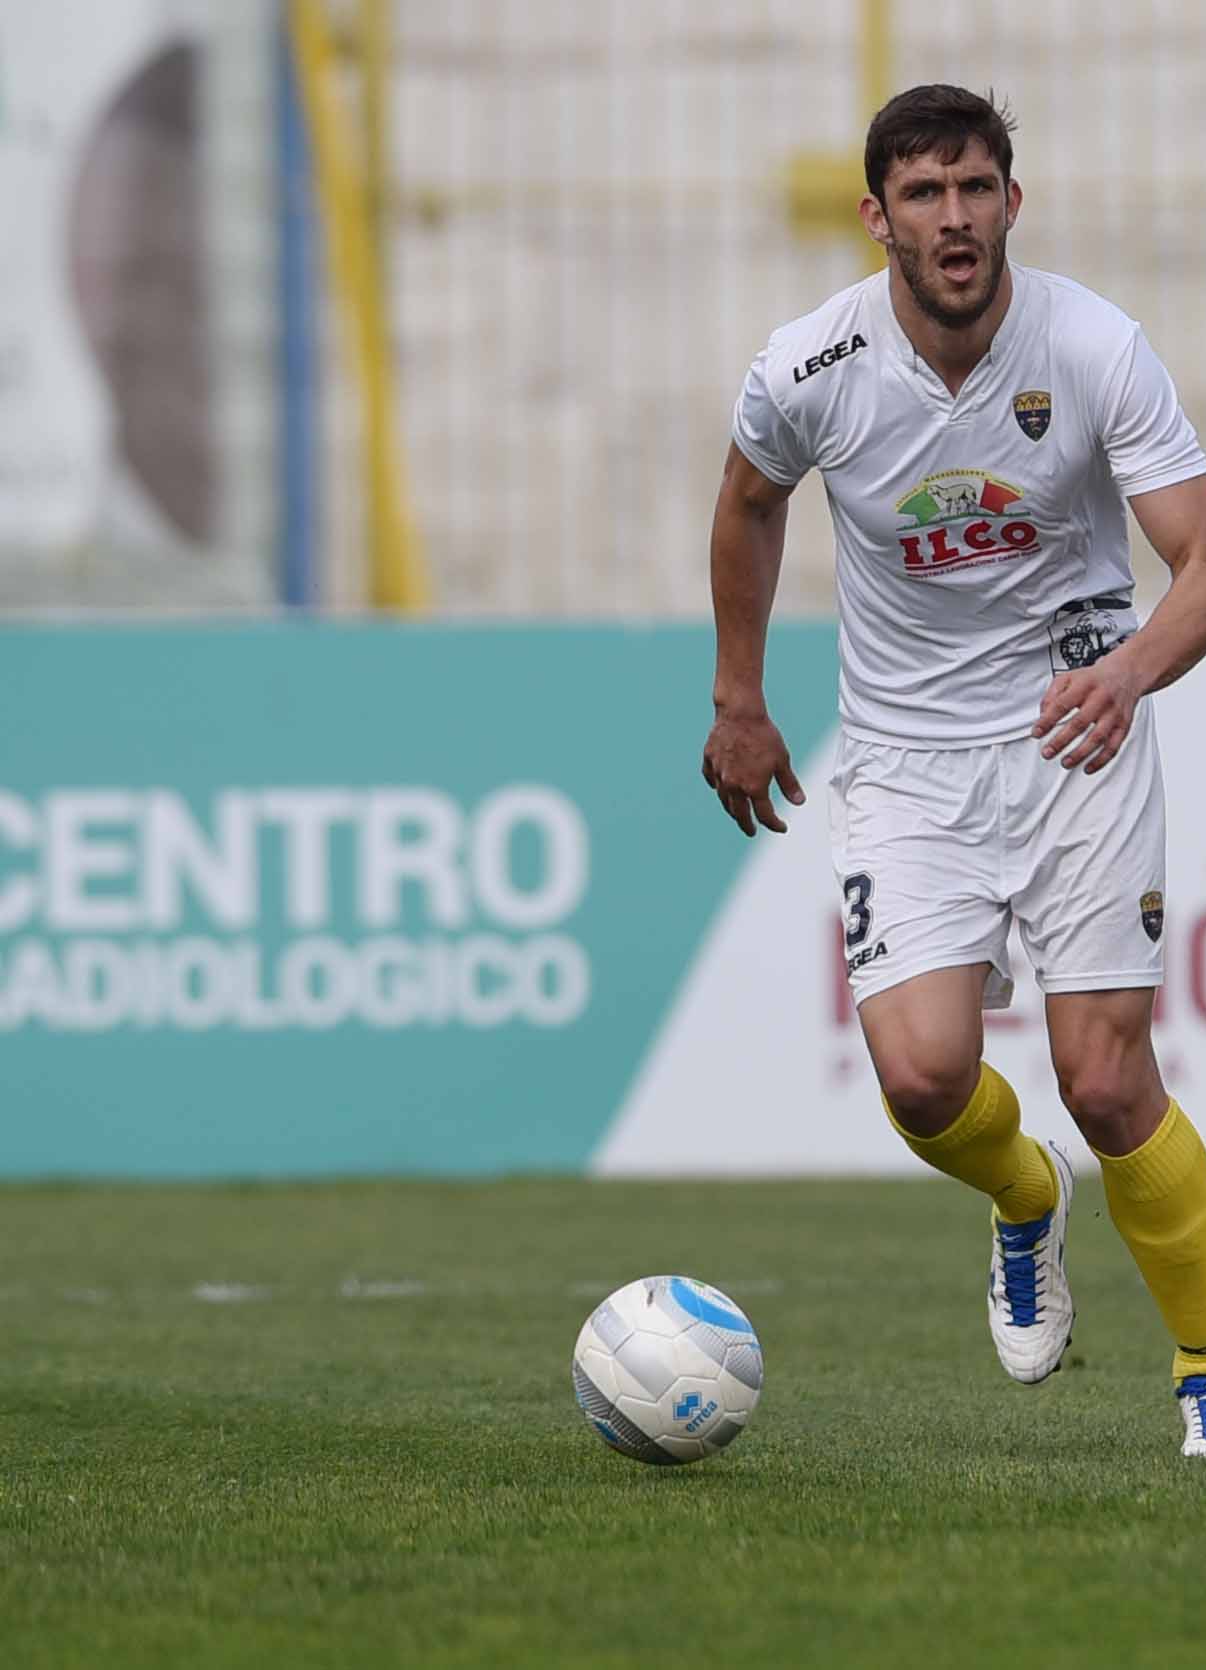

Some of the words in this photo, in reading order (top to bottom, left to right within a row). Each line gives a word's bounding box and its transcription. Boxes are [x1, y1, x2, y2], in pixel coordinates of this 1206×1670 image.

[793, 333, 868, 385] LEGEA
[898, 520, 1038, 565] ILCO
[843, 871, 875, 948] 3
[0, 934, 590, 1029] ADIOLOGICO
